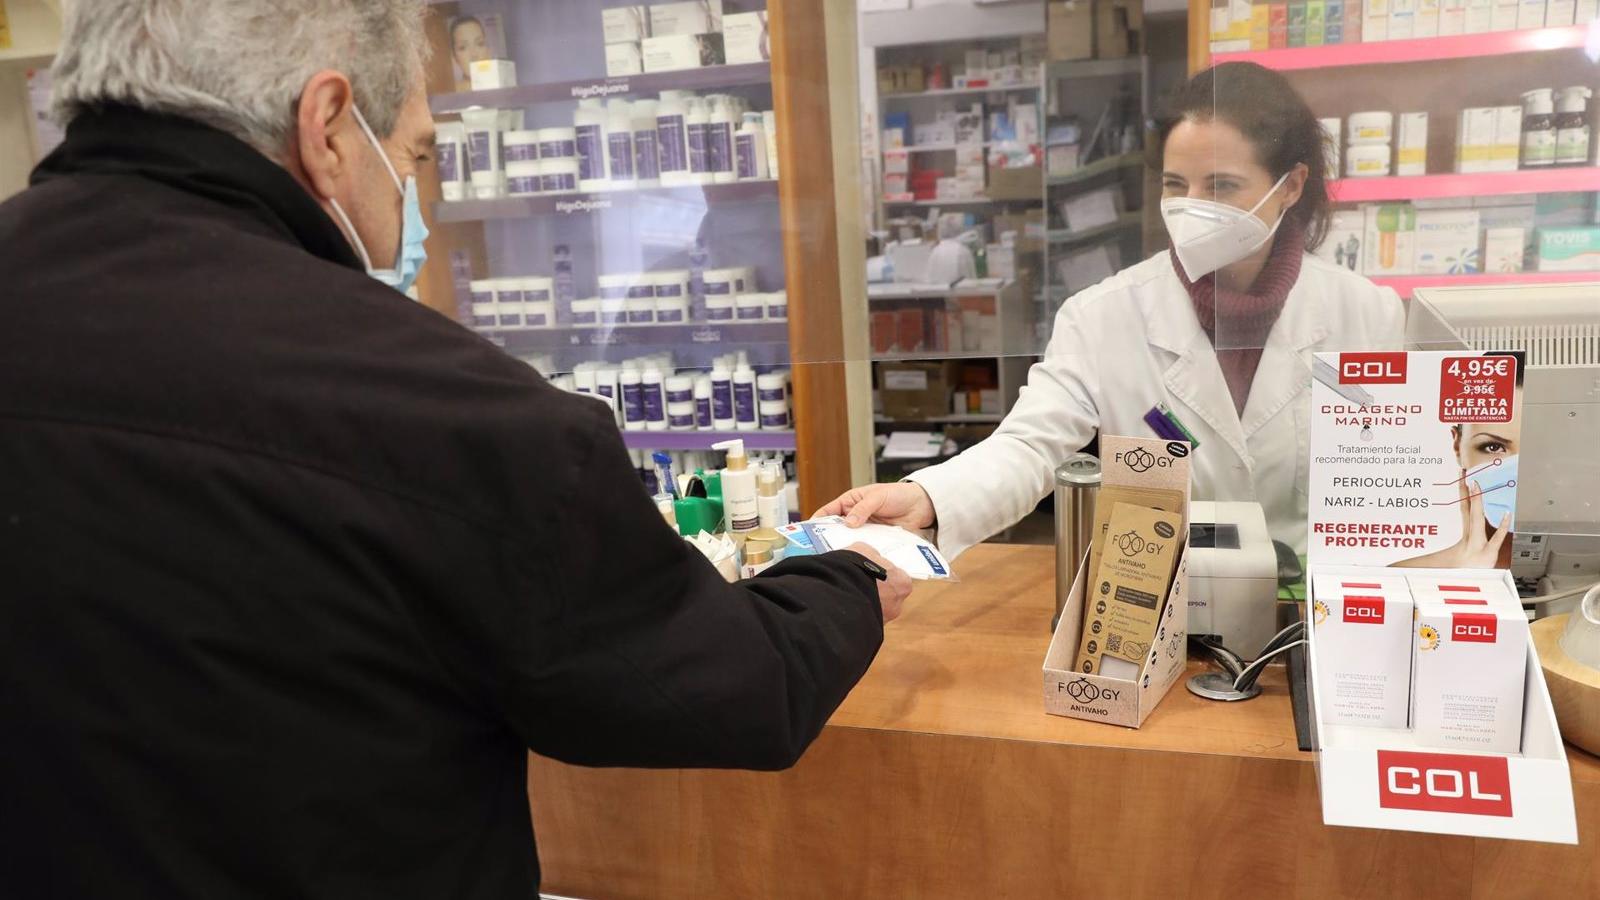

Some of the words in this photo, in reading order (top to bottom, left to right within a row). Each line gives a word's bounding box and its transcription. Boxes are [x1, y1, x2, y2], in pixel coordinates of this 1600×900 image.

[1343, 361, 1402, 378] COL
[1447, 359, 1508, 379] 4,95€
[1321, 402, 1422, 414] COLÁGENO
[1444, 398, 1508, 407] OFERTA
[1444, 407, 1508, 416] LIMITADA
[1335, 417, 1407, 426] MARINO
[1337, 444, 1393, 454] Tratamiento
[1395, 445, 1421, 454] facial
[1315, 455, 1381, 465] recomendado
[1383, 456, 1405, 467] para
[1408, 456, 1417, 465] la
[1419, 457, 1443, 465] zona
[1333, 477, 1422, 488] PERIOCULAR
[1324, 496, 1365, 507] NARIZ
[1377, 497, 1429, 508] LABIOS
[1313, 522, 1439, 535] REGENERANTE
[1325, 536, 1425, 548] PROTECTOR
[1346, 606, 1382, 618] COL
[1454, 625, 1494, 636] COL
[1070, 704, 1109, 716] ANTIVAHO
[1387, 766, 1502, 801] COL
